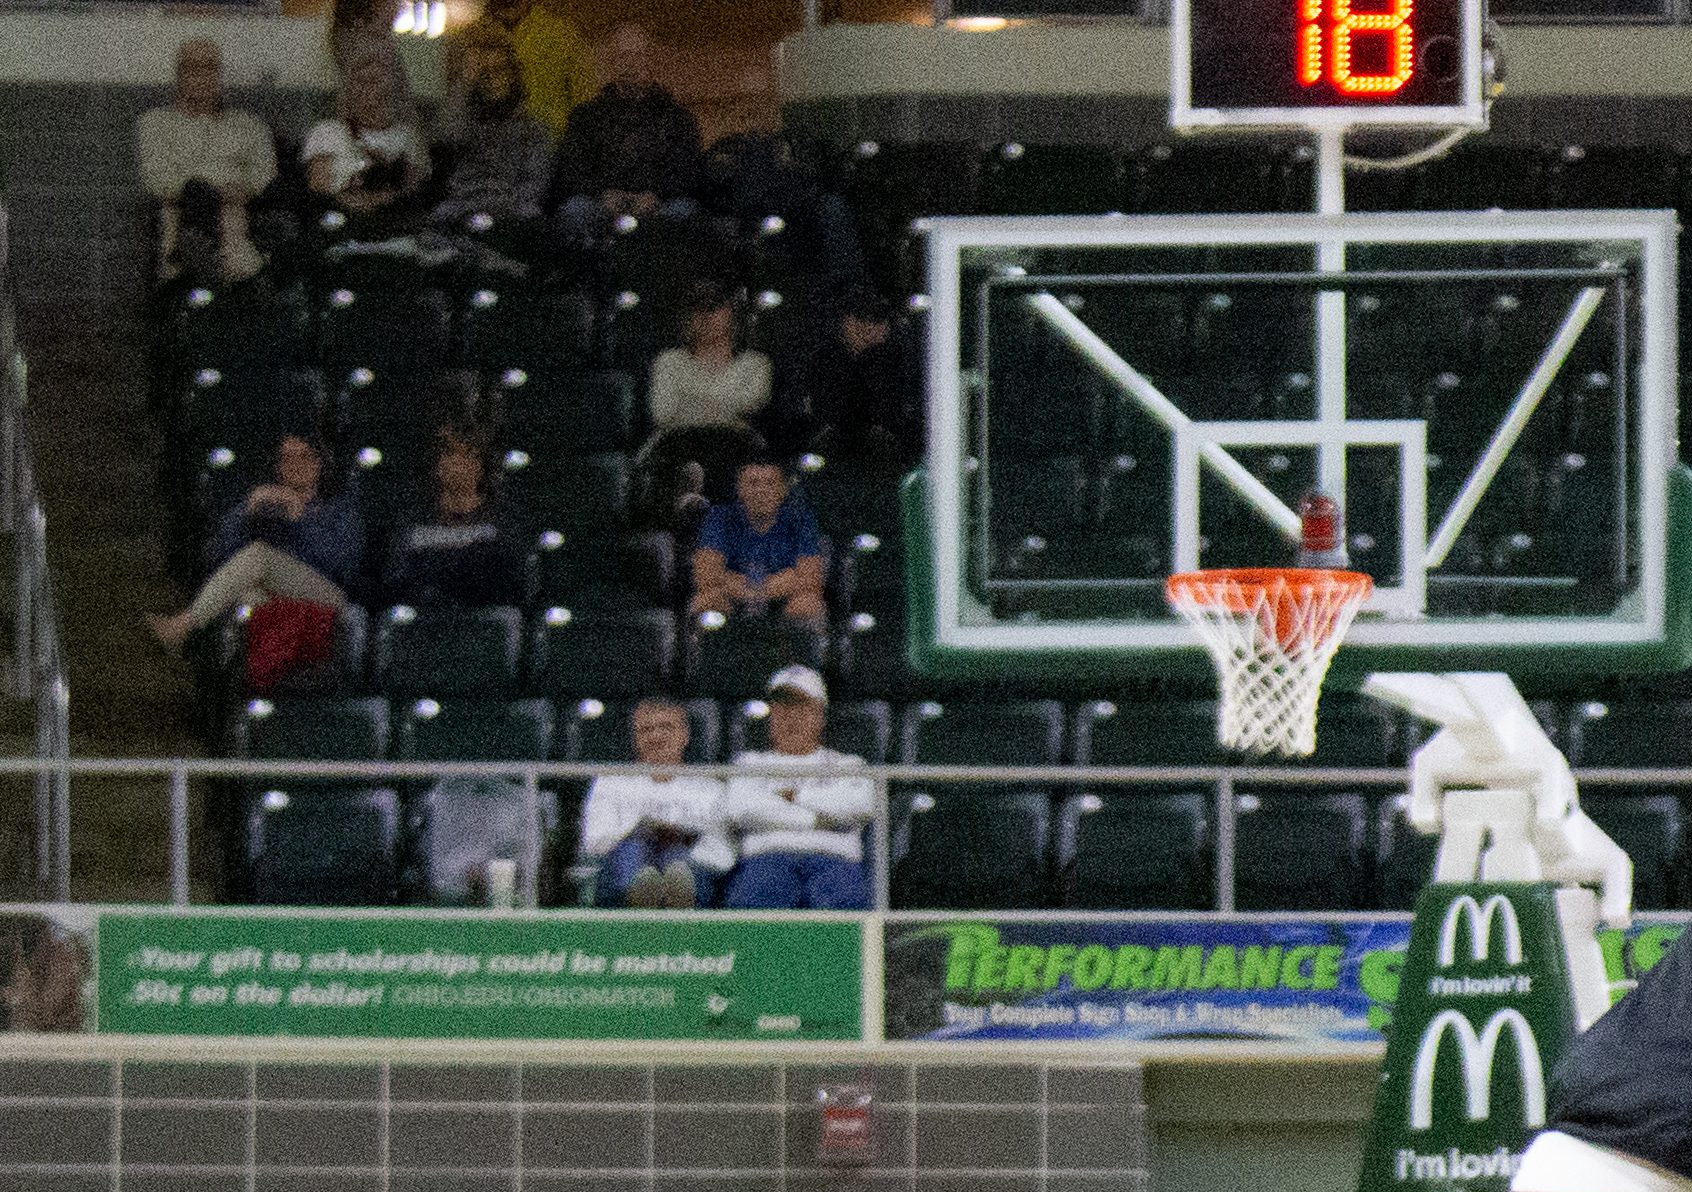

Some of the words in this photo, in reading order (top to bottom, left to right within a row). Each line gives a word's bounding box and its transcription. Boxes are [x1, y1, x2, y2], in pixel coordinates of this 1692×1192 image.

[1297, 0, 1413, 96] 18
[139, 946, 205, 971] Your
[209, 946, 263, 977] gift
[269, 950, 302, 971] to
[306, 947, 481, 978] scholarships
[486, 950, 566, 973] could
[571, 949, 607, 973] be
[613, 950, 736, 974] matched
[943, 921, 1346, 993] PERFORMANCE
[188, 985, 228, 1005] on
[233, 982, 282, 1005] the
[288, 981, 386, 1006] dollar!
